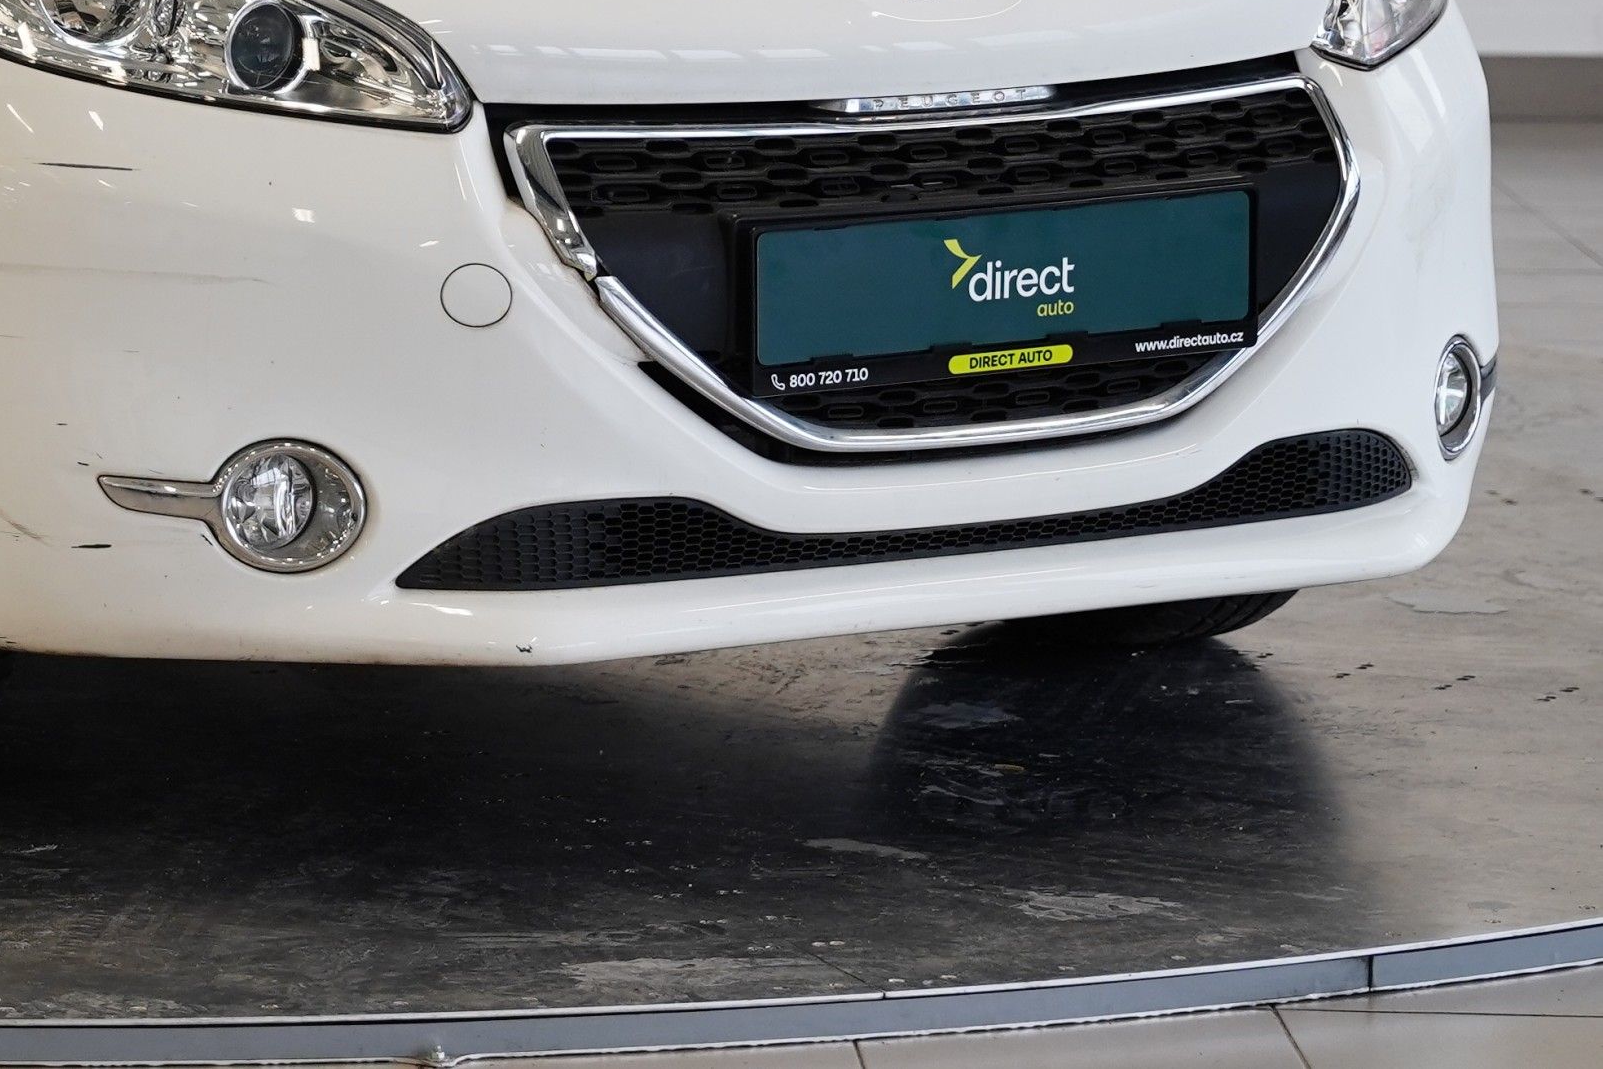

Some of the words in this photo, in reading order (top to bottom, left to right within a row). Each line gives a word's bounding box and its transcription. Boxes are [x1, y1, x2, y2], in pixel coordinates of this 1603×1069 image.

[872, 89, 1026, 109] PEUGEOT
[968, 256, 1076, 302] direct
[1037, 299, 1074, 317] auto
[1135, 332, 1244, 352] www.directauto.cz
[969, 353, 1015, 369] DIRECT
[1018, 349, 1053, 364] AUTO
[789, 372, 816, 388] 800
[818, 370, 843, 385] 720
[845, 367, 869, 383] 710
